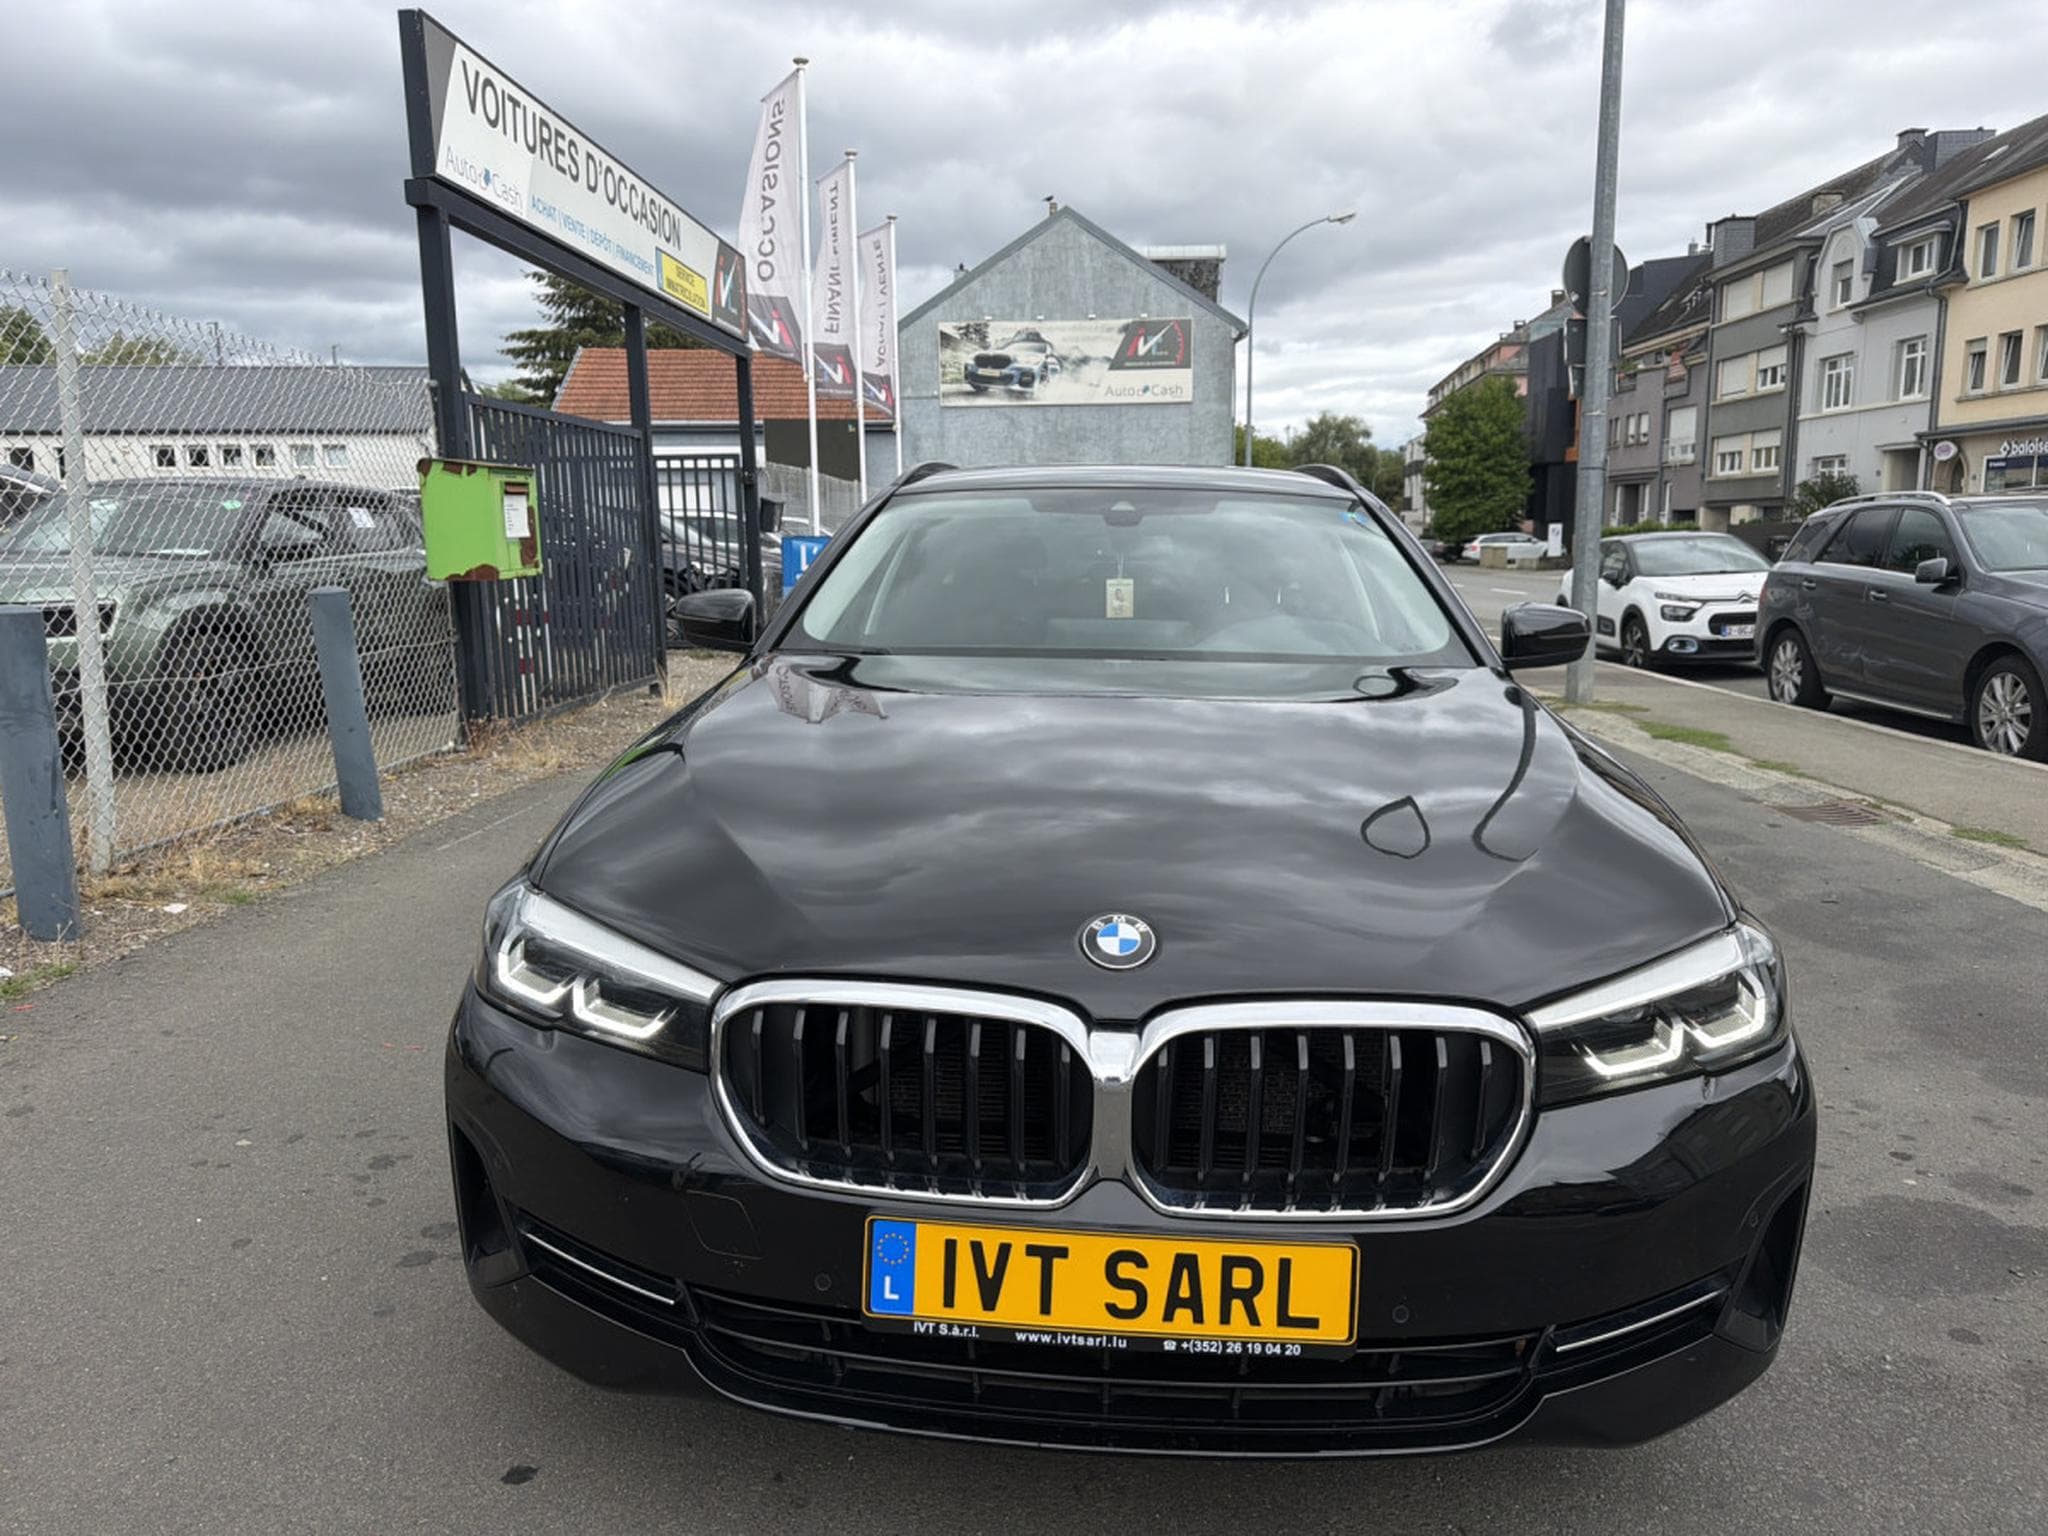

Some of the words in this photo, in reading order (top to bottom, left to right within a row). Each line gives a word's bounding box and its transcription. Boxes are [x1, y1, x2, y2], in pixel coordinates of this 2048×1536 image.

[461, 59, 580, 184] VOITURES
[585, 150, 681, 251] D'OCCASION
[1152, 384, 1184, 397] Cash
[883, 1275, 899, 1301] L
[942, 1237, 1069, 1317] IVT
[1104, 1248, 1320, 1330] SARL
[913, 1321, 936, 1333] IVT
[1015, 1331, 1128, 1348] www.ivtsarl.lu
[1181, 1339, 1222, 1354] +(352)
[1226, 1342, 1242, 1354] 26
[1247, 1343, 1261, 1354] 19
[1265, 1344, 1281, 1355] 04
[1285, 1344, 1301, 1356] 20
